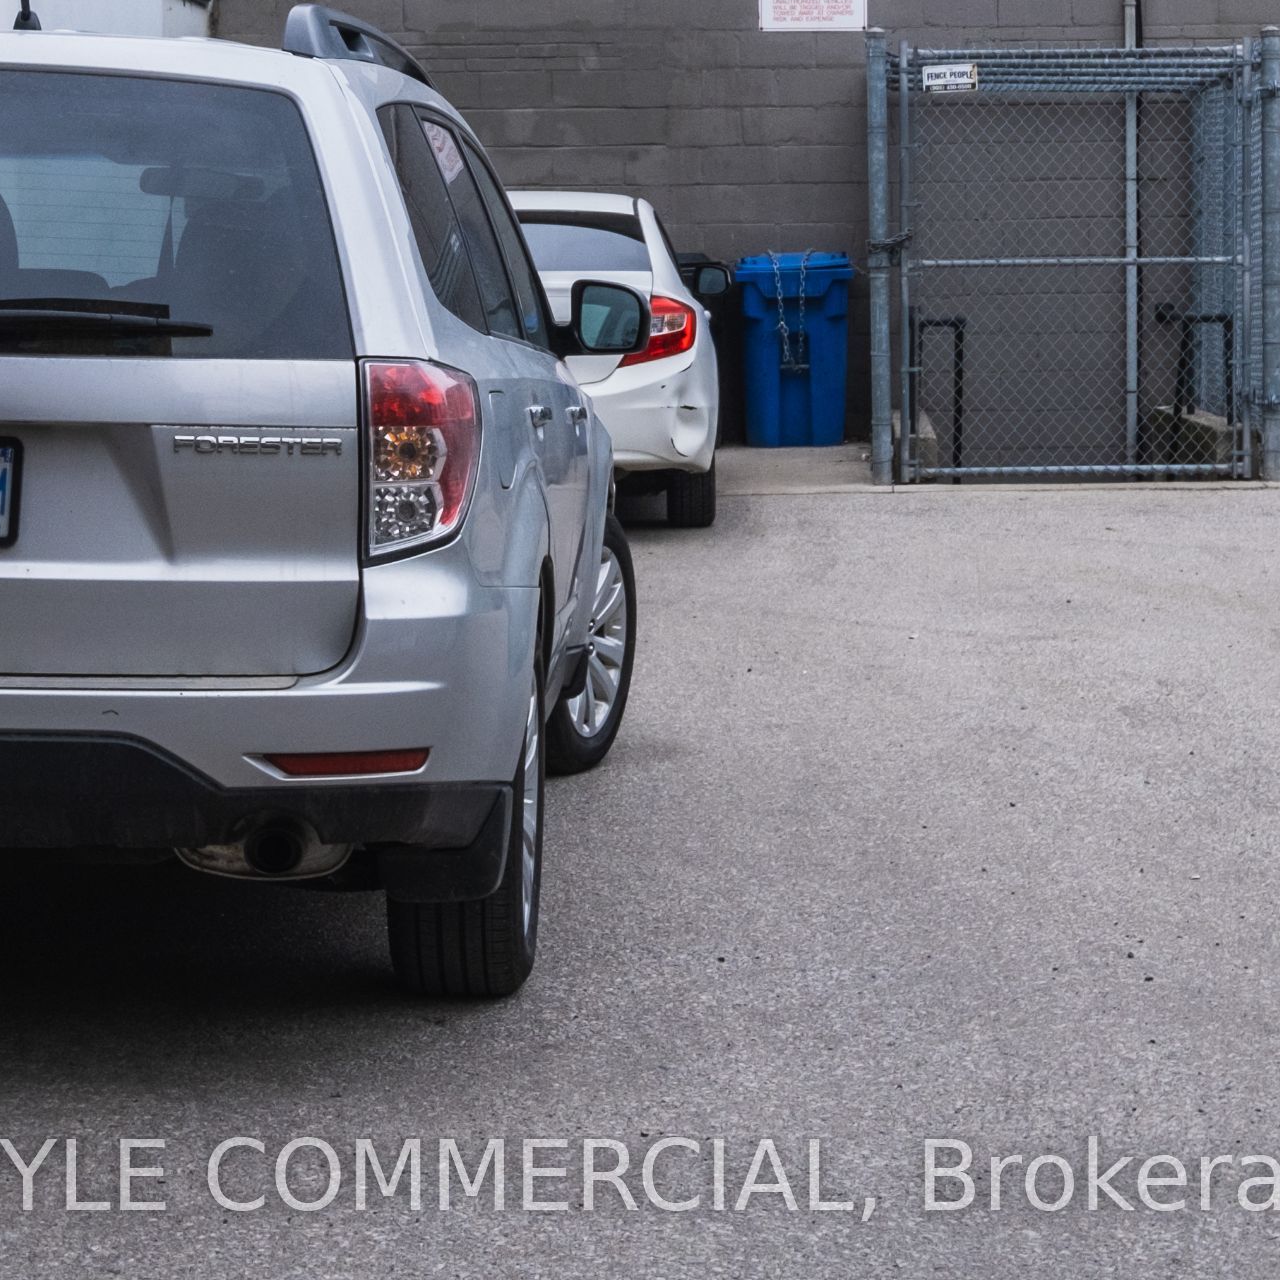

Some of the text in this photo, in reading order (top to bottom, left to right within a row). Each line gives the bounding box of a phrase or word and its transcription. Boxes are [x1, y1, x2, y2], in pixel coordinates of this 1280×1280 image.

[927, 70, 974, 81] FENCE PEOPLE
[173, 435, 343, 456] FORESTER
